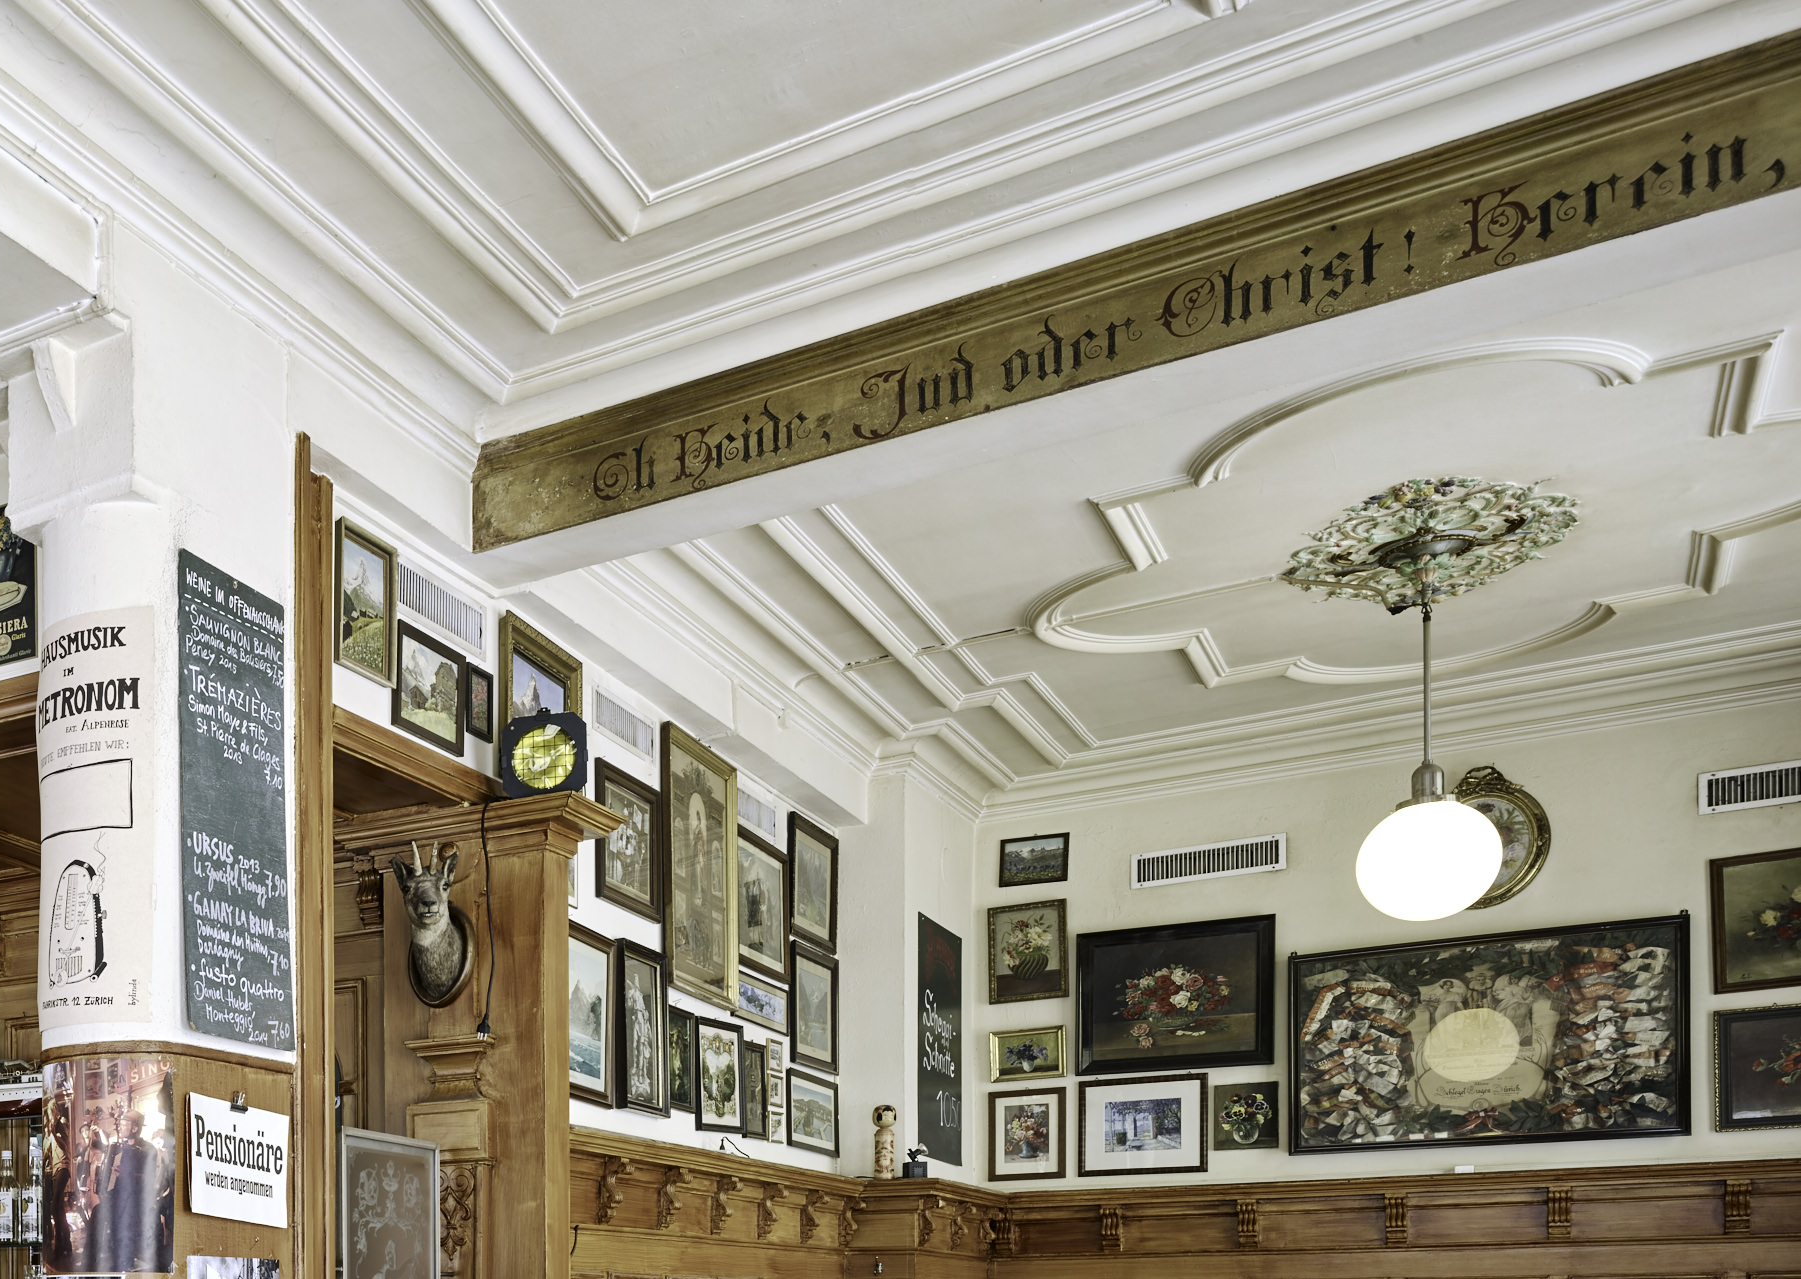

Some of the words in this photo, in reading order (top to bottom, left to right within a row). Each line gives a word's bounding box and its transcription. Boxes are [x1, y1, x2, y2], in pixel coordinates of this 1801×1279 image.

[852, 341, 974, 440] Jud
[1000, 314, 1142, 393] oder
[186, 567, 212, 597] WEINE
[215, 586, 225, 606] IM
[190, 604, 250, 651] SAUVIGNON
[253, 637, 284, 666] BLANC
[191, 625, 226, 652] Domaine
[227, 642, 238, 660] des
[63, 667, 74, 677] IM
[218, 655, 237, 674] 2015
[38, 677, 140, 733] METRONOM
[188, 694, 215, 719] Simon
[218, 704, 240, 733] Maye
[241, 720, 247, 734] &
[211, 721, 237, 749] Pierre
[240, 739, 250, 756] de
[223, 745, 242, 764] 2013
[193, 831, 234, 864] URSUS
[238, 855, 260, 874] 2013
[263, 869, 286, 898] 7.90
[193, 891, 233, 927] GAMAY
[235, 907, 247, 928] LA
[197, 920, 230, 943] Domaine
[193, 980, 224, 1002] Daniel
[199, 958, 237, 988] fusto
[240, 977, 284, 1005] quattro
[72, 996, 81, 1006] 12
[248, 1028, 268, 1046] 2014
[267, 1020, 290, 1048] 7.60
[194, 1113, 283, 1175] Pensionäre
[204, 1170, 228, 1189] werden
[230, 1176, 273, 1198] angenommen
